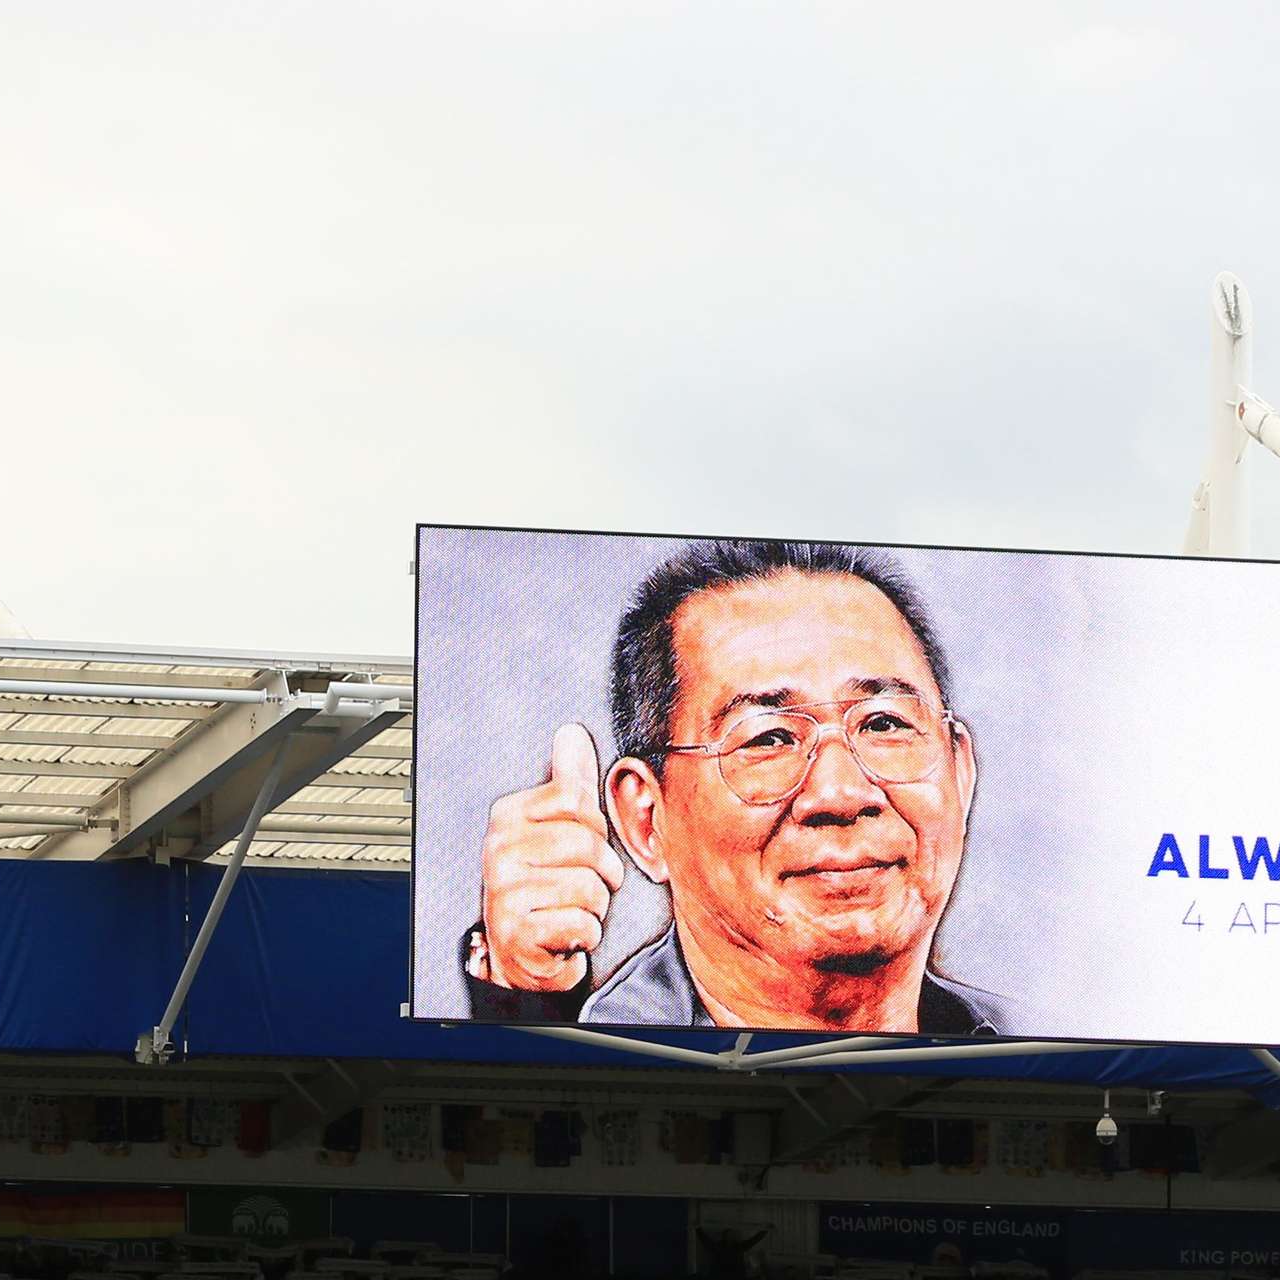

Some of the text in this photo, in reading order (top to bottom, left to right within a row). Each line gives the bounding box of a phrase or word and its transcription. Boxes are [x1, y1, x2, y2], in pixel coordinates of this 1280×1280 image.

[1180, 901, 1205, 933] 4
[828, 1215, 1061, 1238] CHAMPIONS OF ENGLAND
[1179, 1249, 1225, 1264] KING
